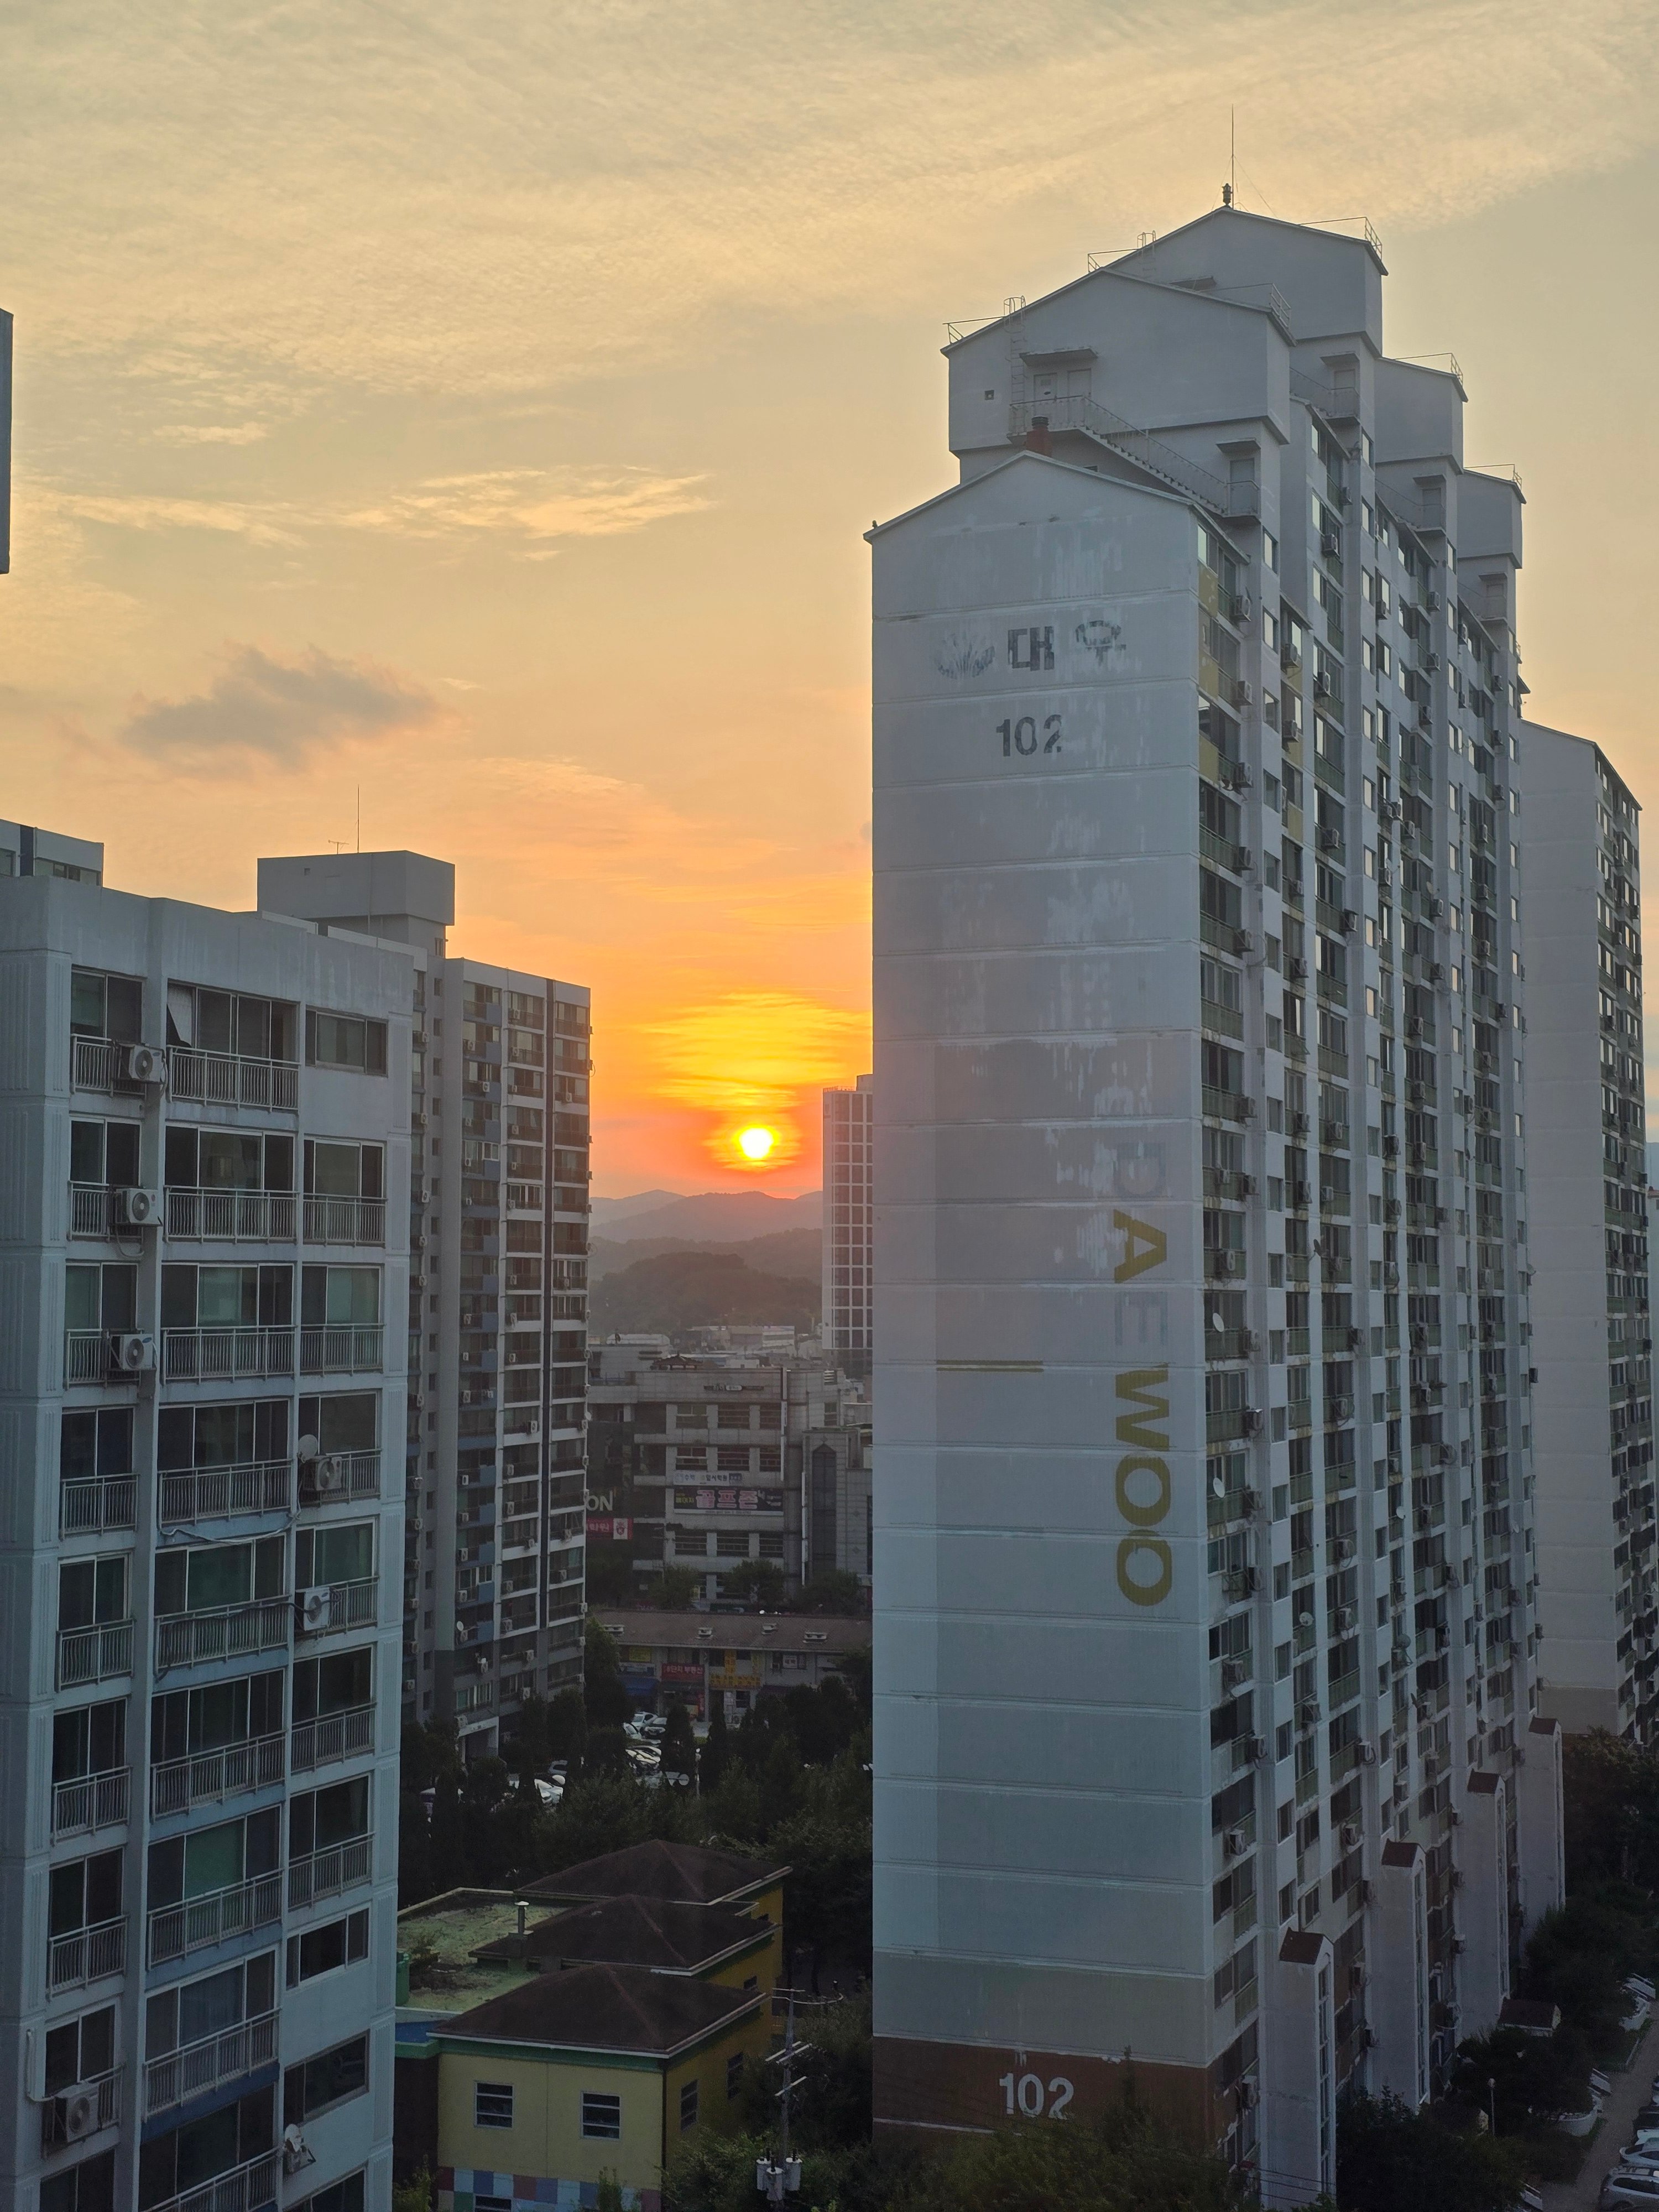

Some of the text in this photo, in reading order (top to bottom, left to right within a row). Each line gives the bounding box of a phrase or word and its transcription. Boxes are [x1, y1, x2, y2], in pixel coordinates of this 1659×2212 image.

[996, 714, 1062, 757] 102
[1114, 1141, 1172, 1606] DAEWOO
[999, 2073, 1074, 2120] 102
